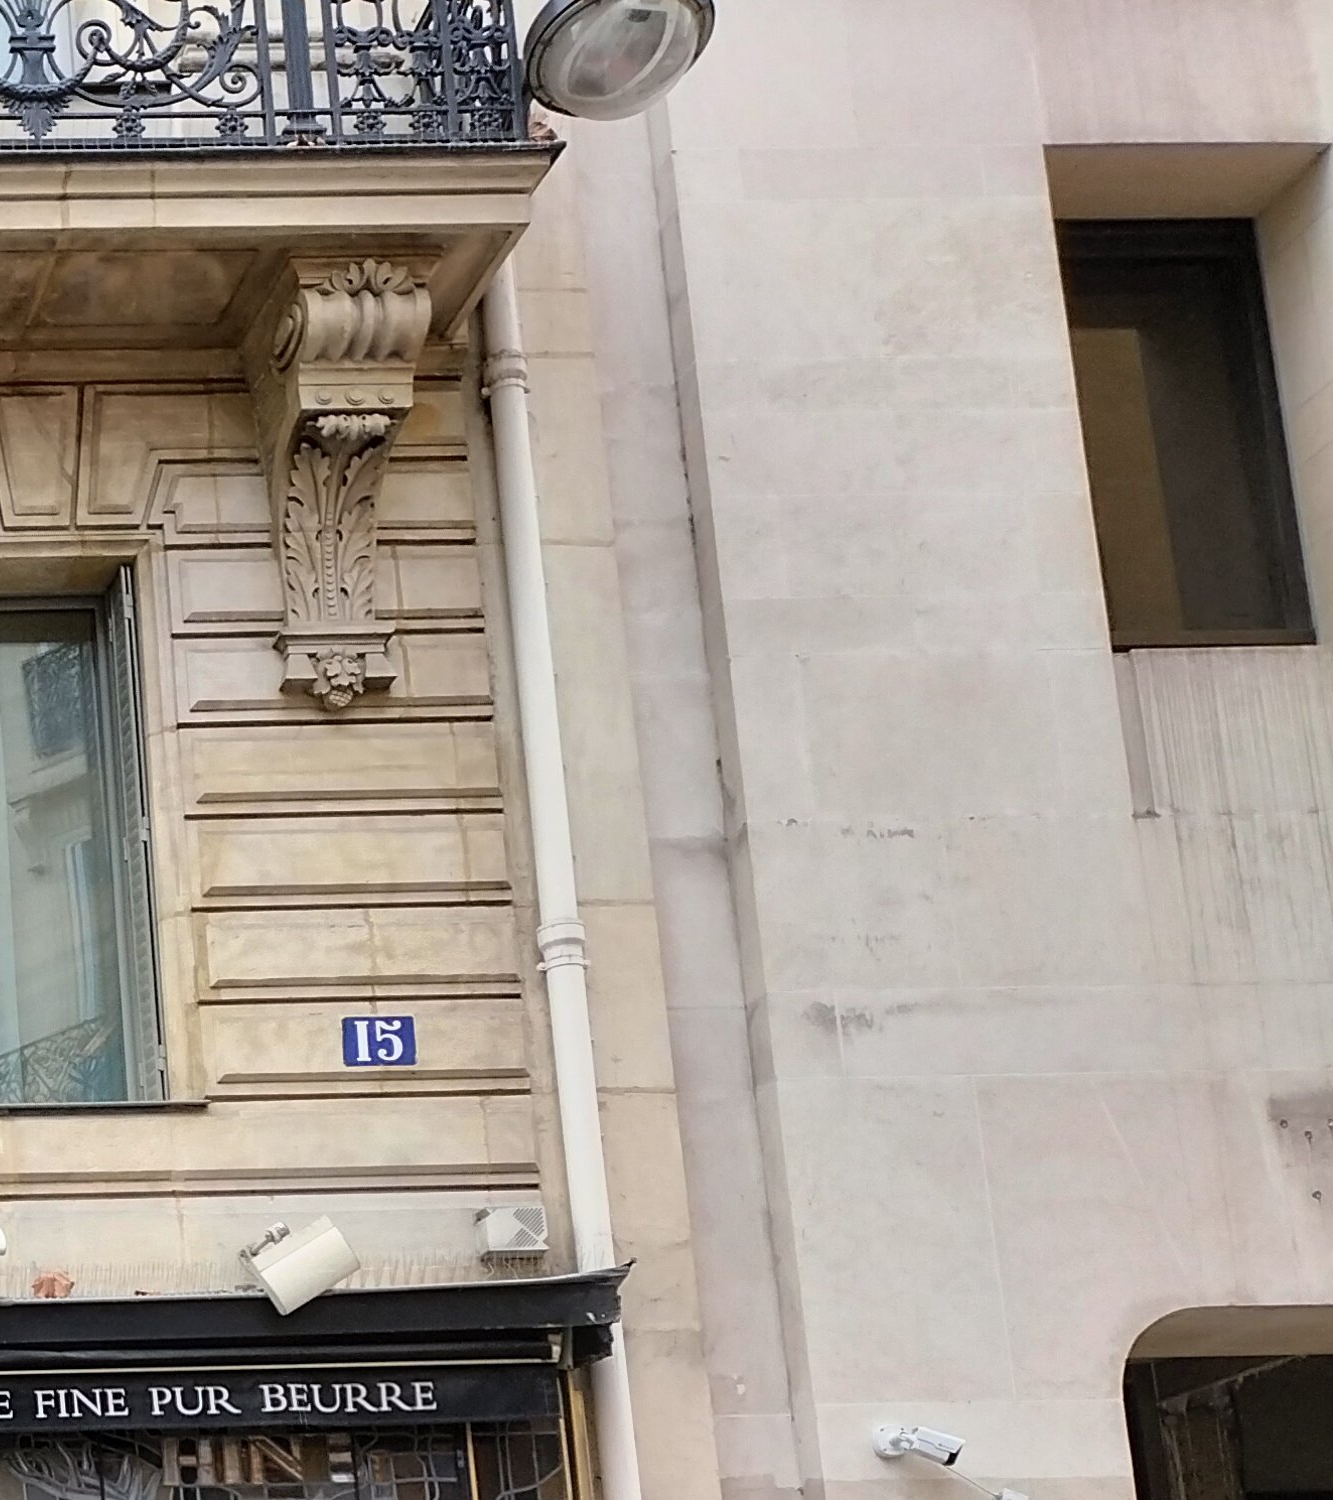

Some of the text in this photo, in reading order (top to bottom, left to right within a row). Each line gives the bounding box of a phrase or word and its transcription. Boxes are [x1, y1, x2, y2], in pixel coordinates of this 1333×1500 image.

[354, 1019, 404, 1062] 15
[34, 1386, 130, 1420] FINE
[148, 1385, 241, 1417] PUR
[258, 1381, 438, 1413] BEURRE
